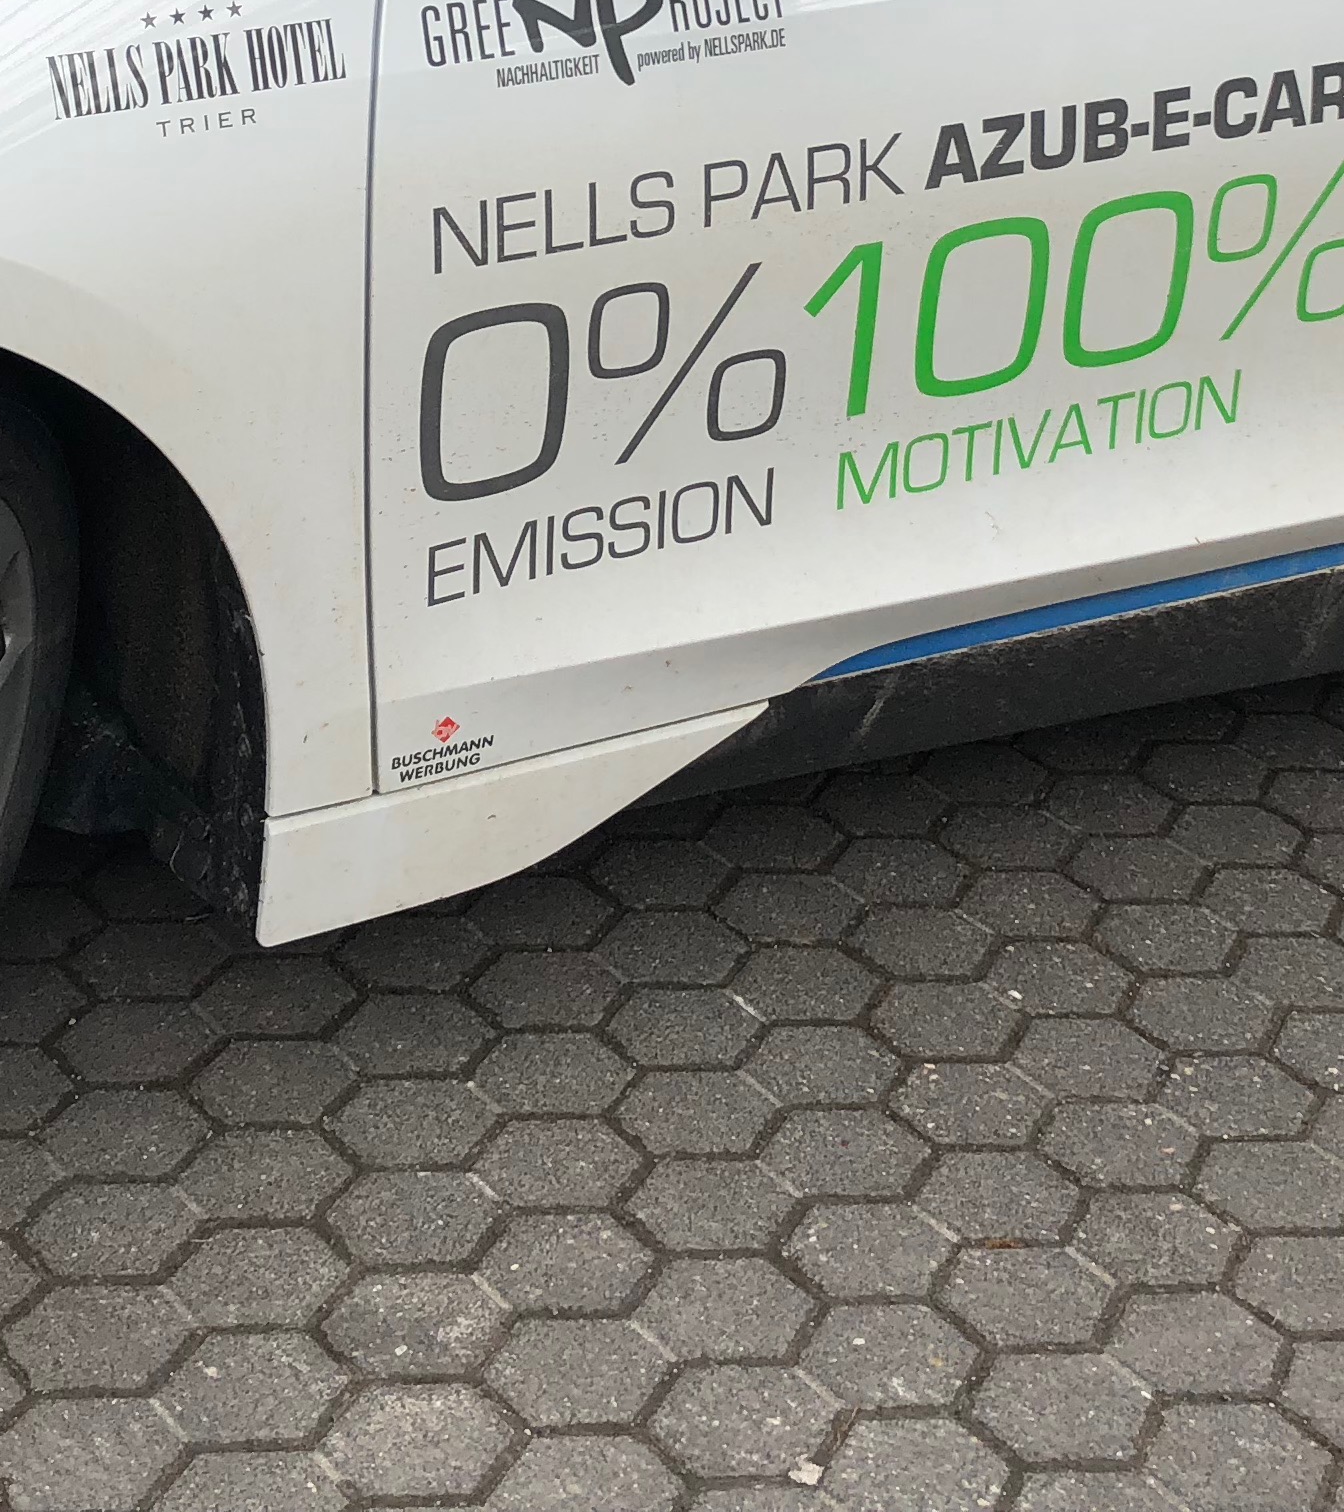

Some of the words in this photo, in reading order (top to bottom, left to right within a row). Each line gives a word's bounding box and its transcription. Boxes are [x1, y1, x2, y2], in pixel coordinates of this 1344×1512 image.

[45, 43, 150, 120] NELLS
[152, 32, 240, 105] PARK
[243, 18, 346, 93] HOTEL
[496, 54, 600, 88] NACHHALTIGKEIT
[637, 43, 685, 71] powered
[688, 39, 701, 64] by
[703, 28, 786, 58] NELLSPARK.DE
[156, 108, 256, 138] TRIER
[431, 170, 676, 274] NELLS
[702, 132, 904, 228] PARK
[418, 261, 787, 502] 0%
[427, 467, 776, 607] EMISSION
[835, 368, 1242, 511] MOTIVATION
[391, 735, 494, 770] BUSCHMANN
[400, 753, 481, 783] WERBUNG
